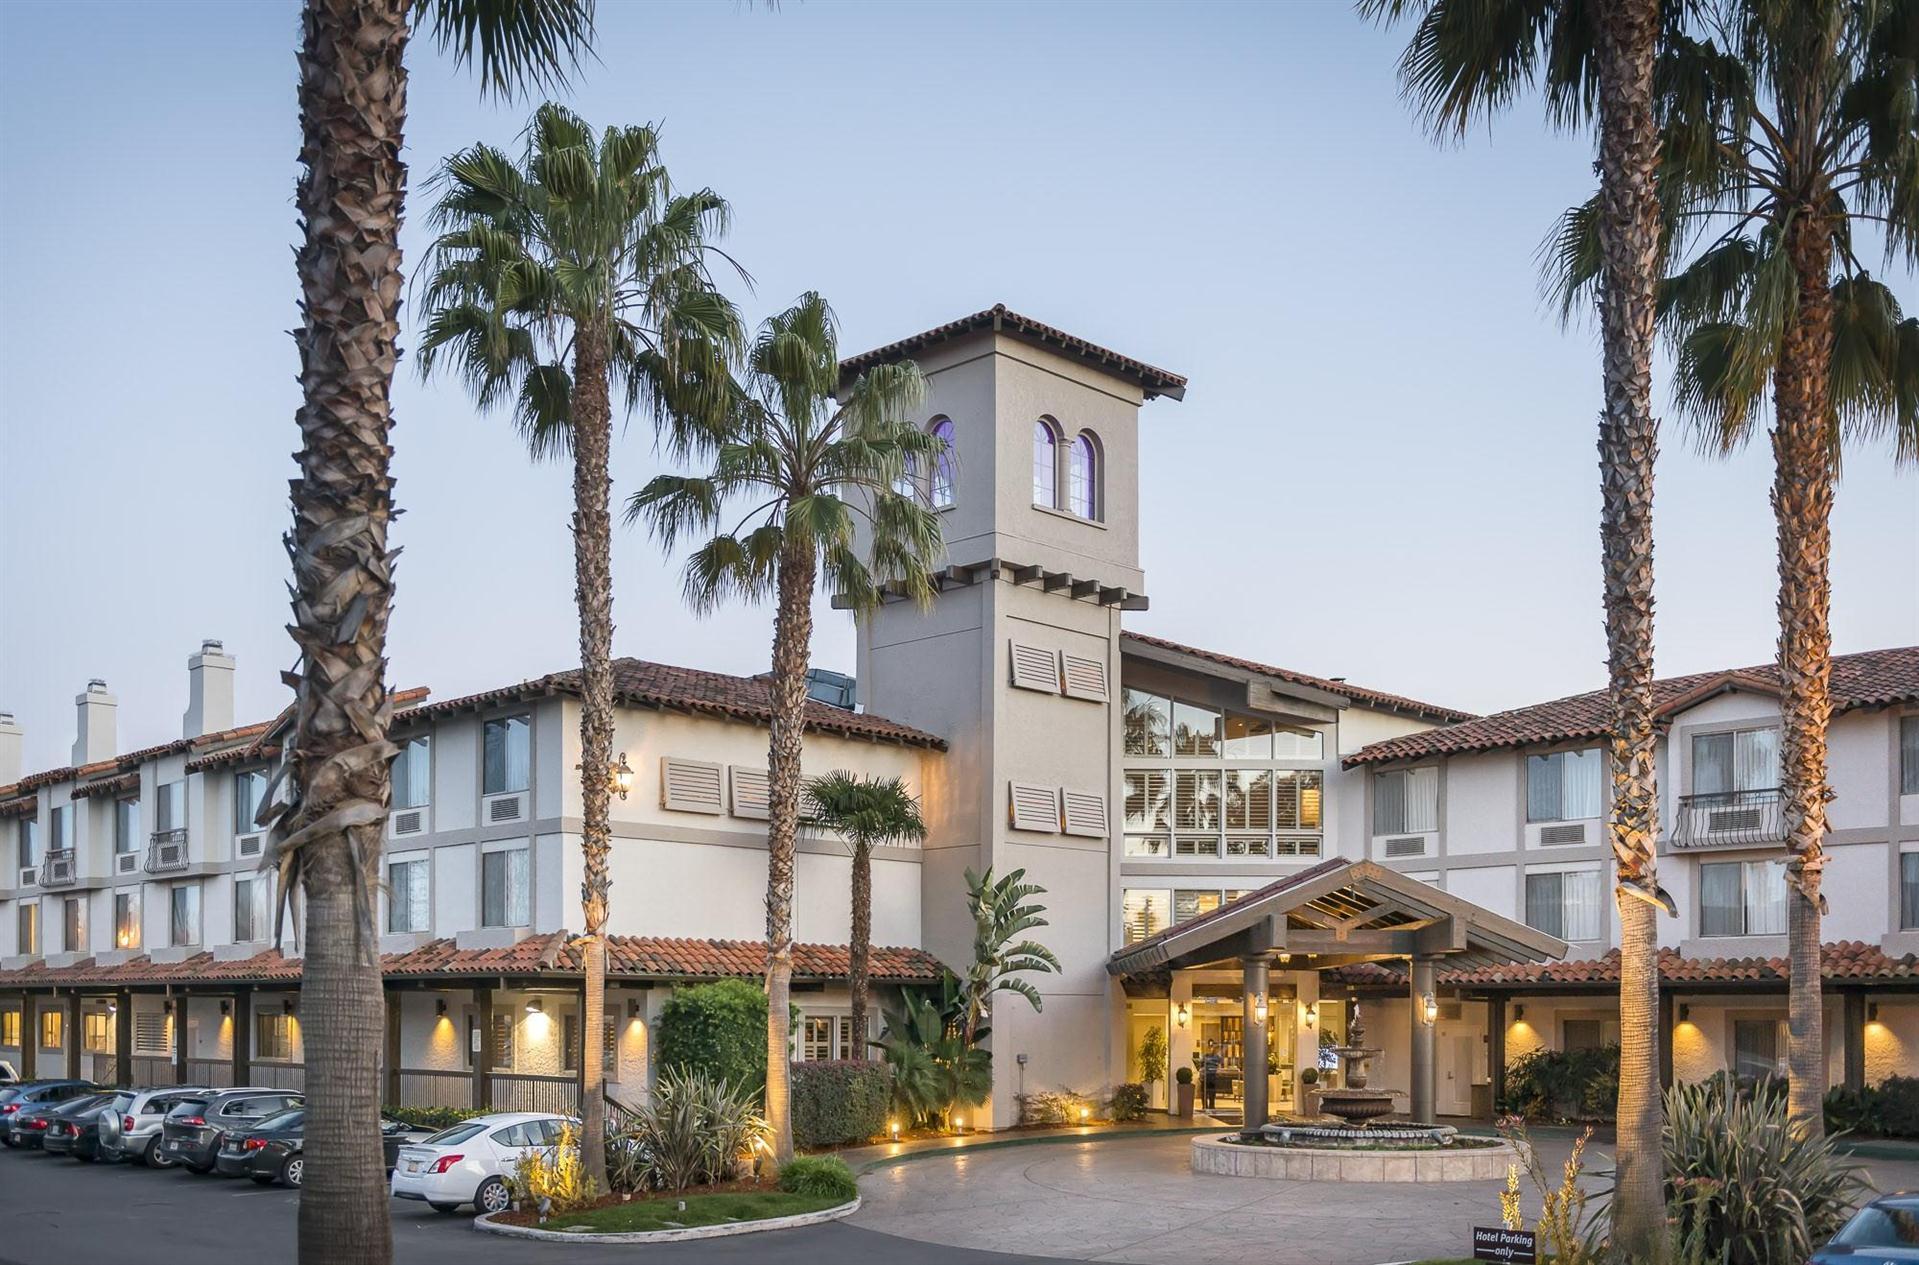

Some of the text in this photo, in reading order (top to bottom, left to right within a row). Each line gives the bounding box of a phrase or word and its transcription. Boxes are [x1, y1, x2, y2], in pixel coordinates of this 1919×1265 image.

[1476, 1231, 1533, 1248] Hotel Parking
[1495, 1246, 1514, 1258] only
